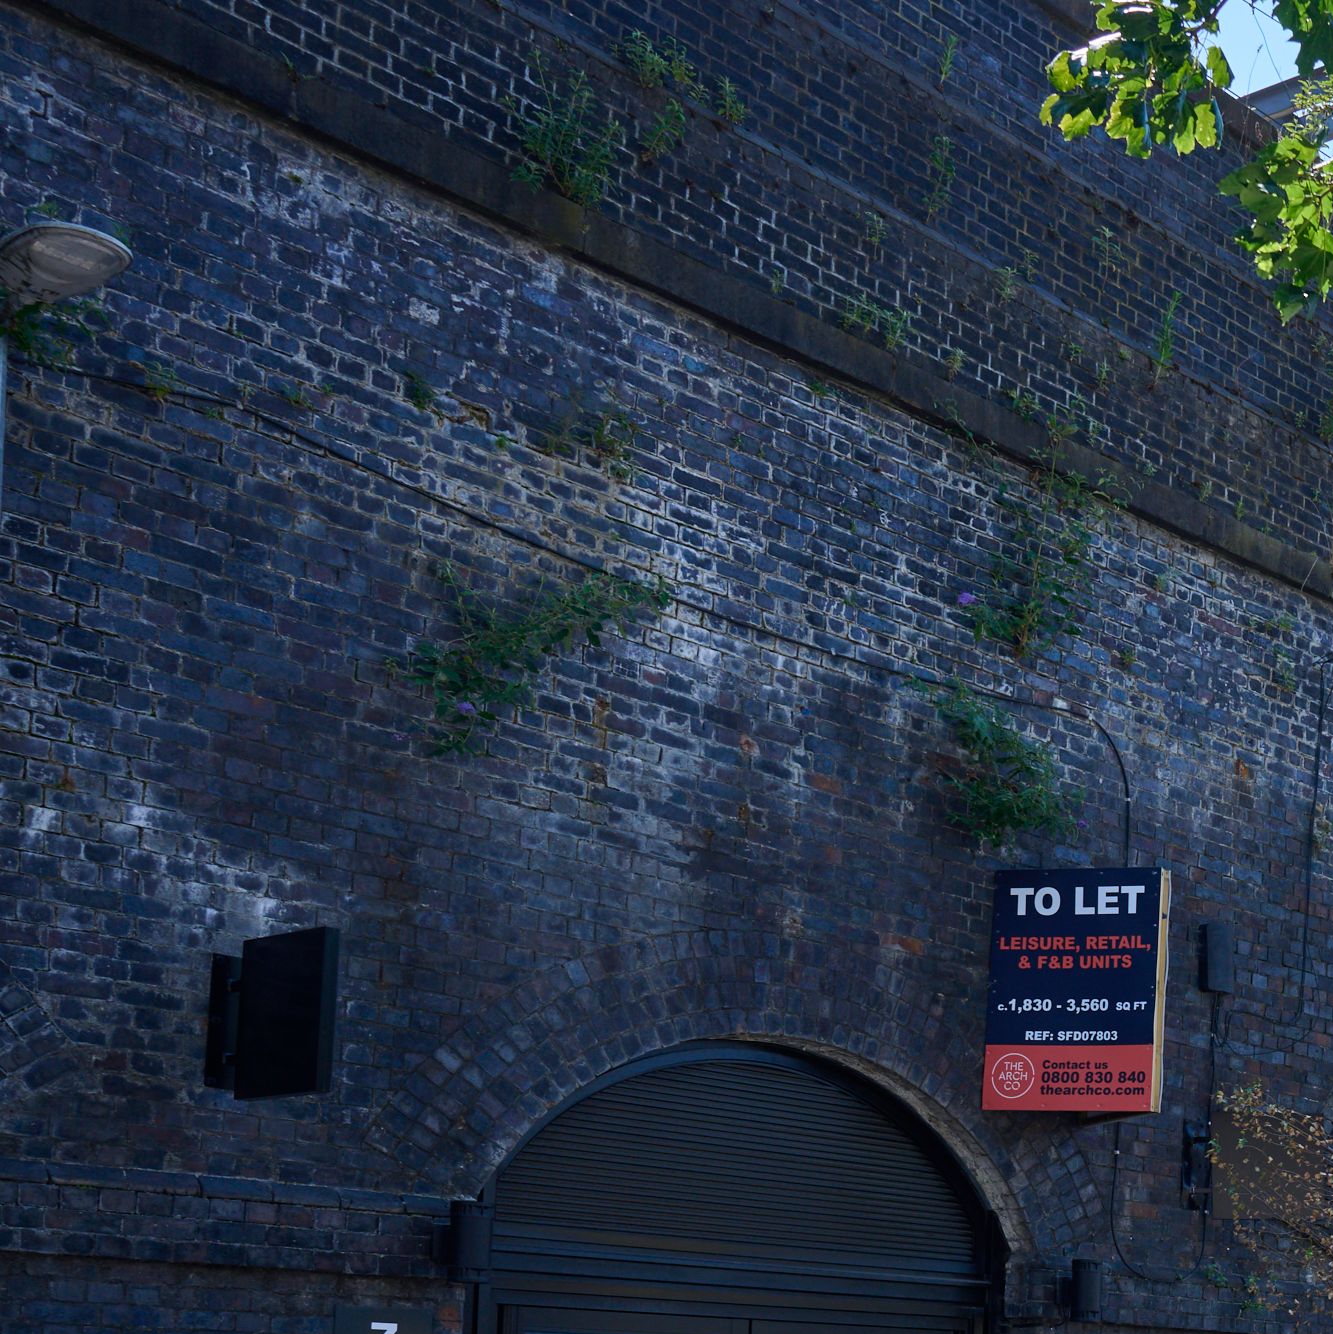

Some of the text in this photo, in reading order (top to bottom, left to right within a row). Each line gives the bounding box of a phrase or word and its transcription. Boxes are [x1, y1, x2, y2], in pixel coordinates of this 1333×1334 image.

[1010, 885, 1146, 916] TO LET
[1000, 936, 1151, 952] LEISURE, RETAIL,
[1018, 955, 1133, 969] & F&B UNITS
[1066, 998, 1109, 1014] 3,560
[1115, 1001, 1131, 1011] SQ
[1133, 1001, 1147, 1010] FT
[1025, 1031, 1118, 1041] REF: SFD07803
[1004, 1061, 1024, 1071] THE
[1042, 1060, 1108, 1070] Contact us
[999, 1071, 1028, 1081] ARCH
[1041, 1071, 1146, 1083] 0800 830 840
[1003, 1081, 1021, 1090] CO
[1040, 1084, 1145, 1096] thearchco.com
